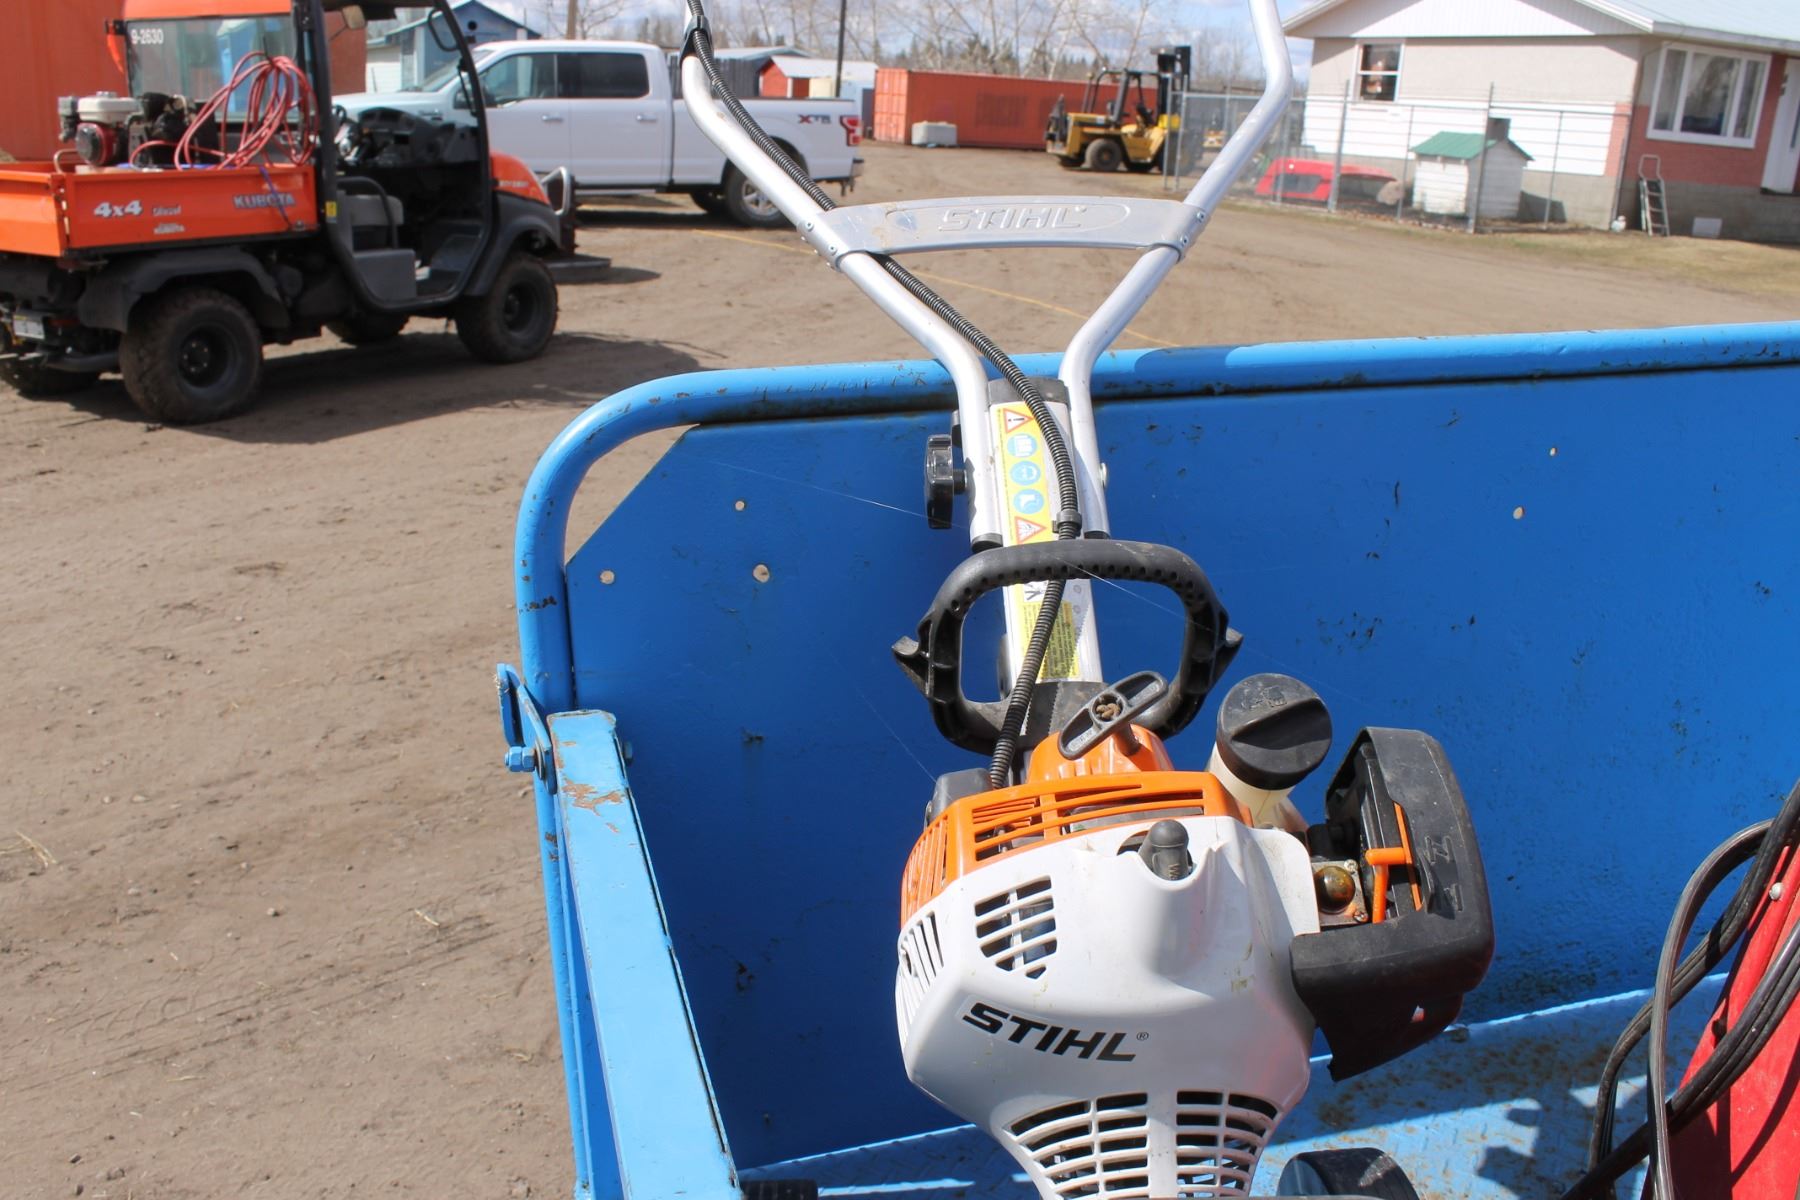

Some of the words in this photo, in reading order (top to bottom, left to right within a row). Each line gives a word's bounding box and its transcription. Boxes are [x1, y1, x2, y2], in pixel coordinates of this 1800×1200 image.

[131, 28, 164, 45] 9-2630
[94, 200, 143, 217] 4x4
[938, 207, 1082, 232] STIHL
